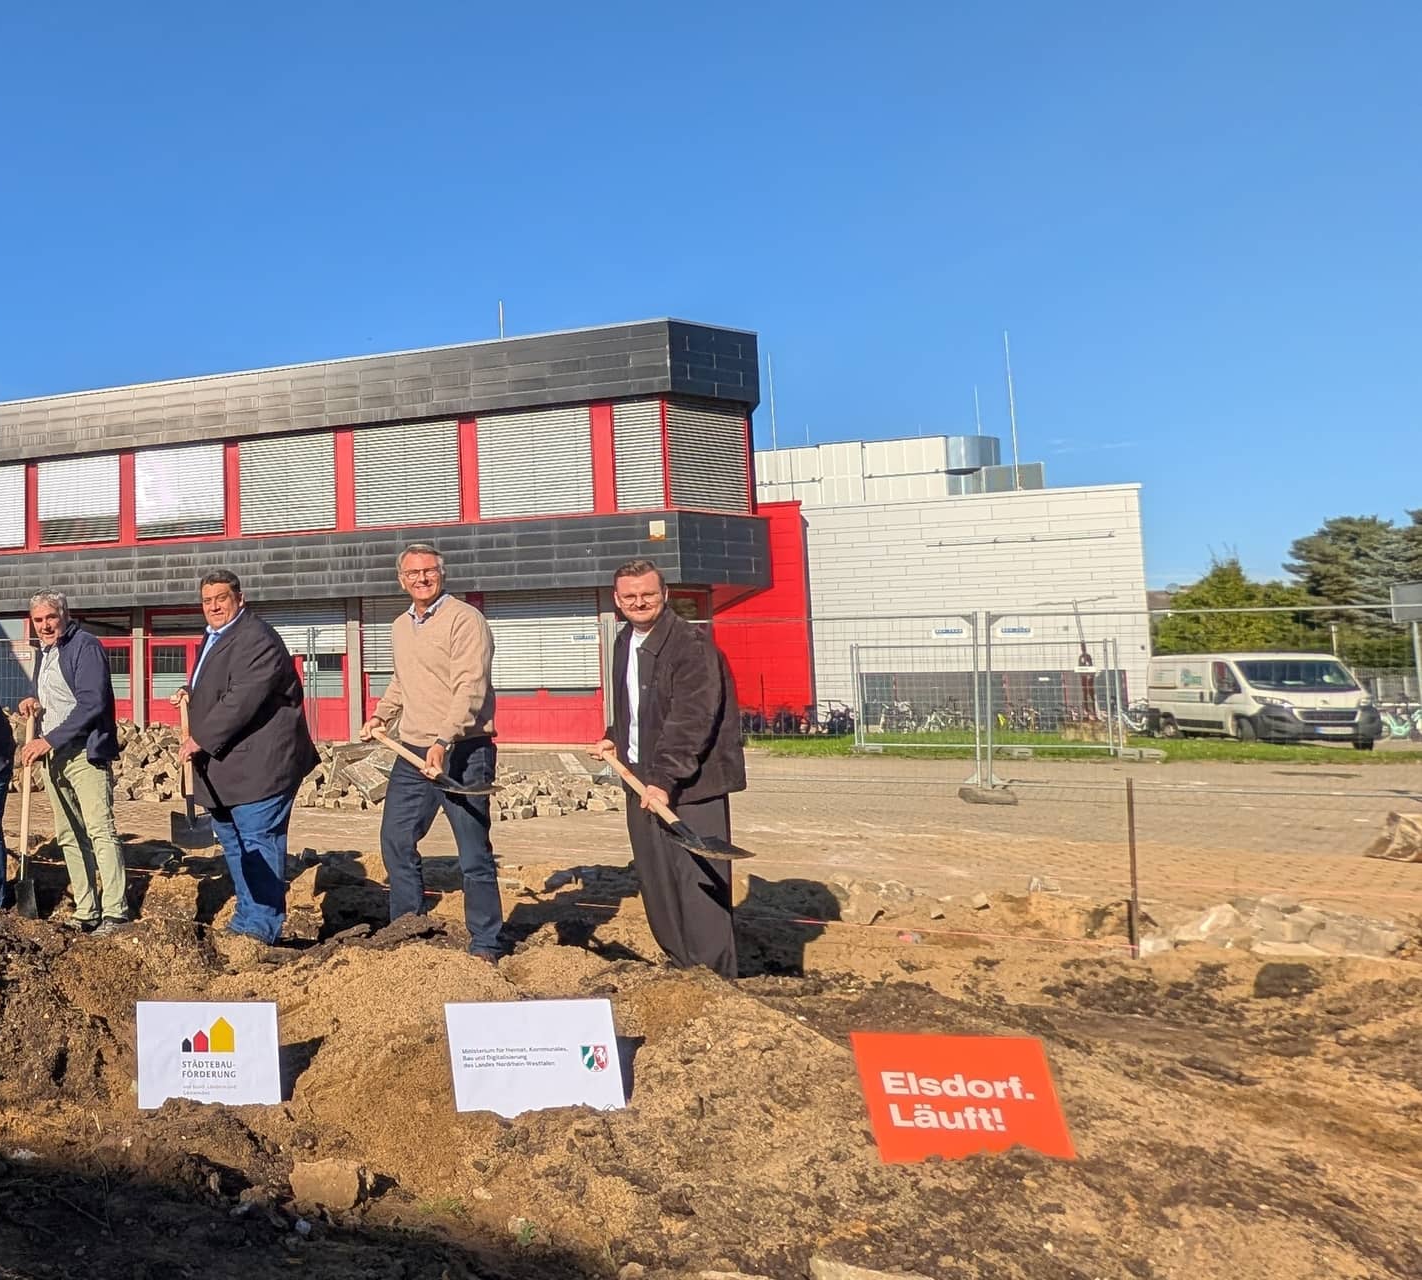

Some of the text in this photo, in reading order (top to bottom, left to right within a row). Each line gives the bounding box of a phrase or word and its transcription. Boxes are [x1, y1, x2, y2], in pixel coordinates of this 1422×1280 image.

[182, 1069, 236, 1078] FÖRDERUNG
[880, 1071, 1035, 1100] Elsdorf.
[888, 1103, 1007, 1132] Läuft!
